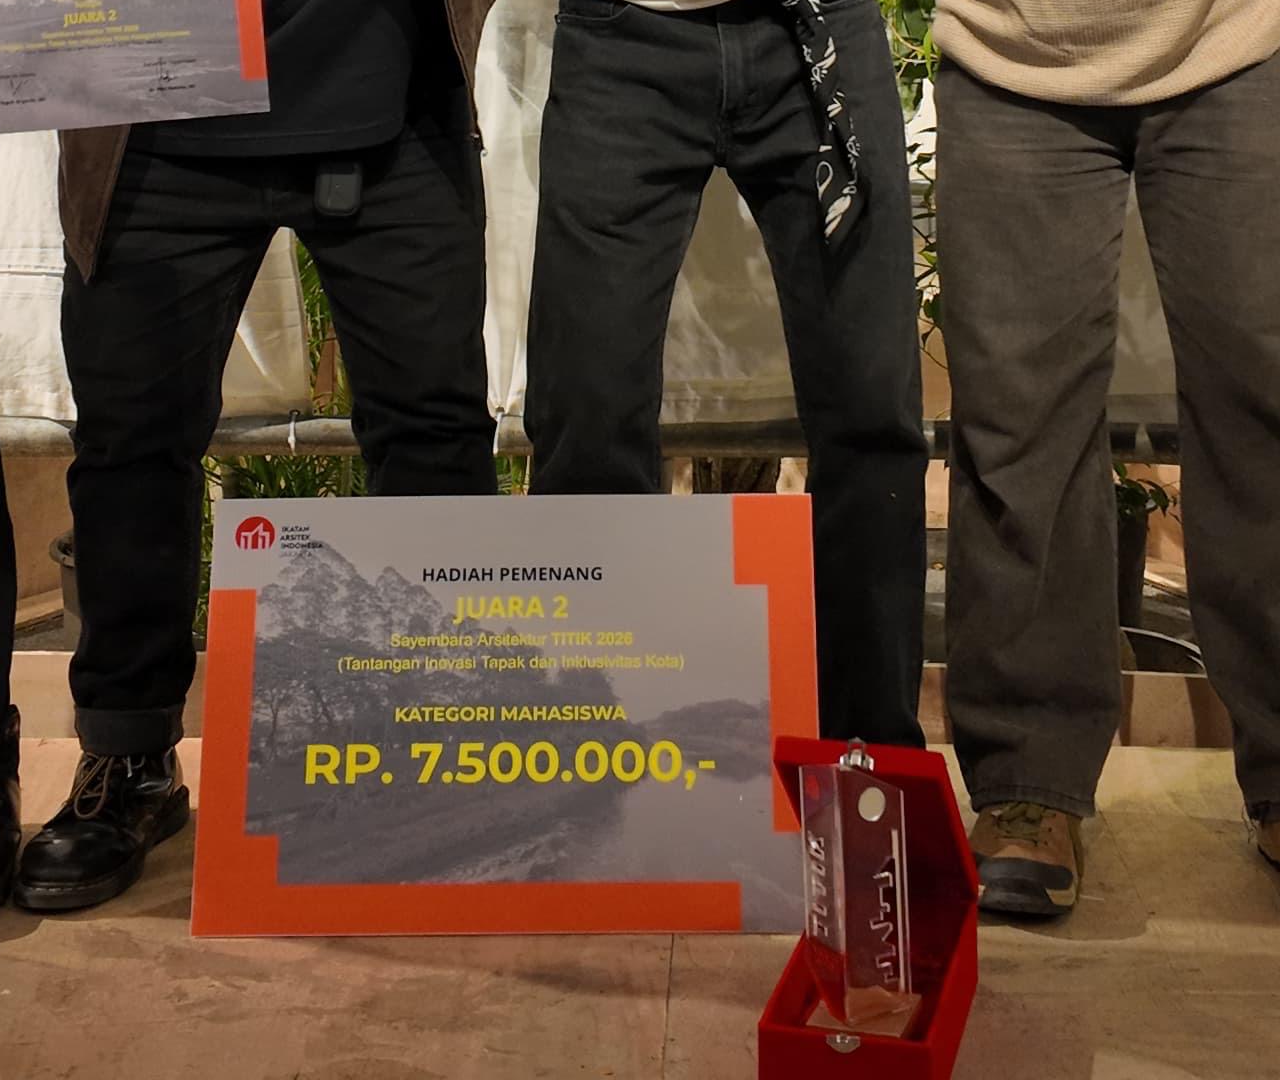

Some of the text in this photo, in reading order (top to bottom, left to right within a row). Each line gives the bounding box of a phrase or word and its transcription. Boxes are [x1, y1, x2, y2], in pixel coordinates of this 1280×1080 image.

[63, 9, 118, 28] JUARA 2
[422, 567, 603, 582] HADIAH PEMENANG
[453, 595, 569, 625] JUARA 2
[390, 631, 634, 649] Sayembara Arsitektur TITIK 2026
[337, 654, 685, 673] (Tantangan Inovasi Tapak dan Inklusivitas Kota)
[394, 704, 628, 723] KATEGORI MAHASISWA
[304, 739, 716, 791] RP. 7.500.000,-
